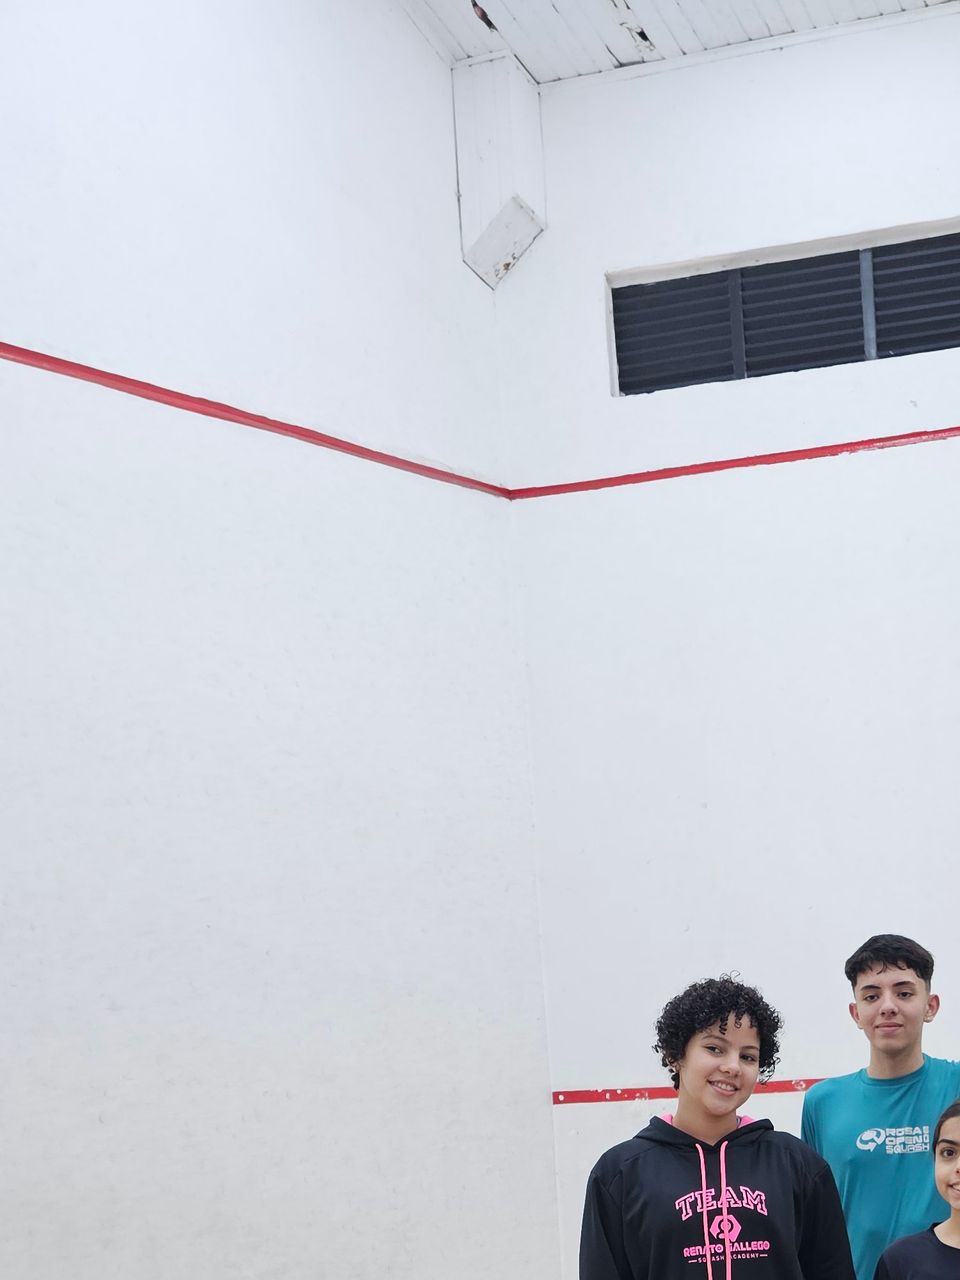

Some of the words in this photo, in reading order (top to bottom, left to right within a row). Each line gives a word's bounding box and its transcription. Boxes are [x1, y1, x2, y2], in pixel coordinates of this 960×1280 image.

[885, 1135, 923, 1146] OPEN
[885, 1142, 930, 1155] SQUASH
[675, 1185, 768, 1222] TEAM
[730, 1252, 759, 1260] CADEMY
